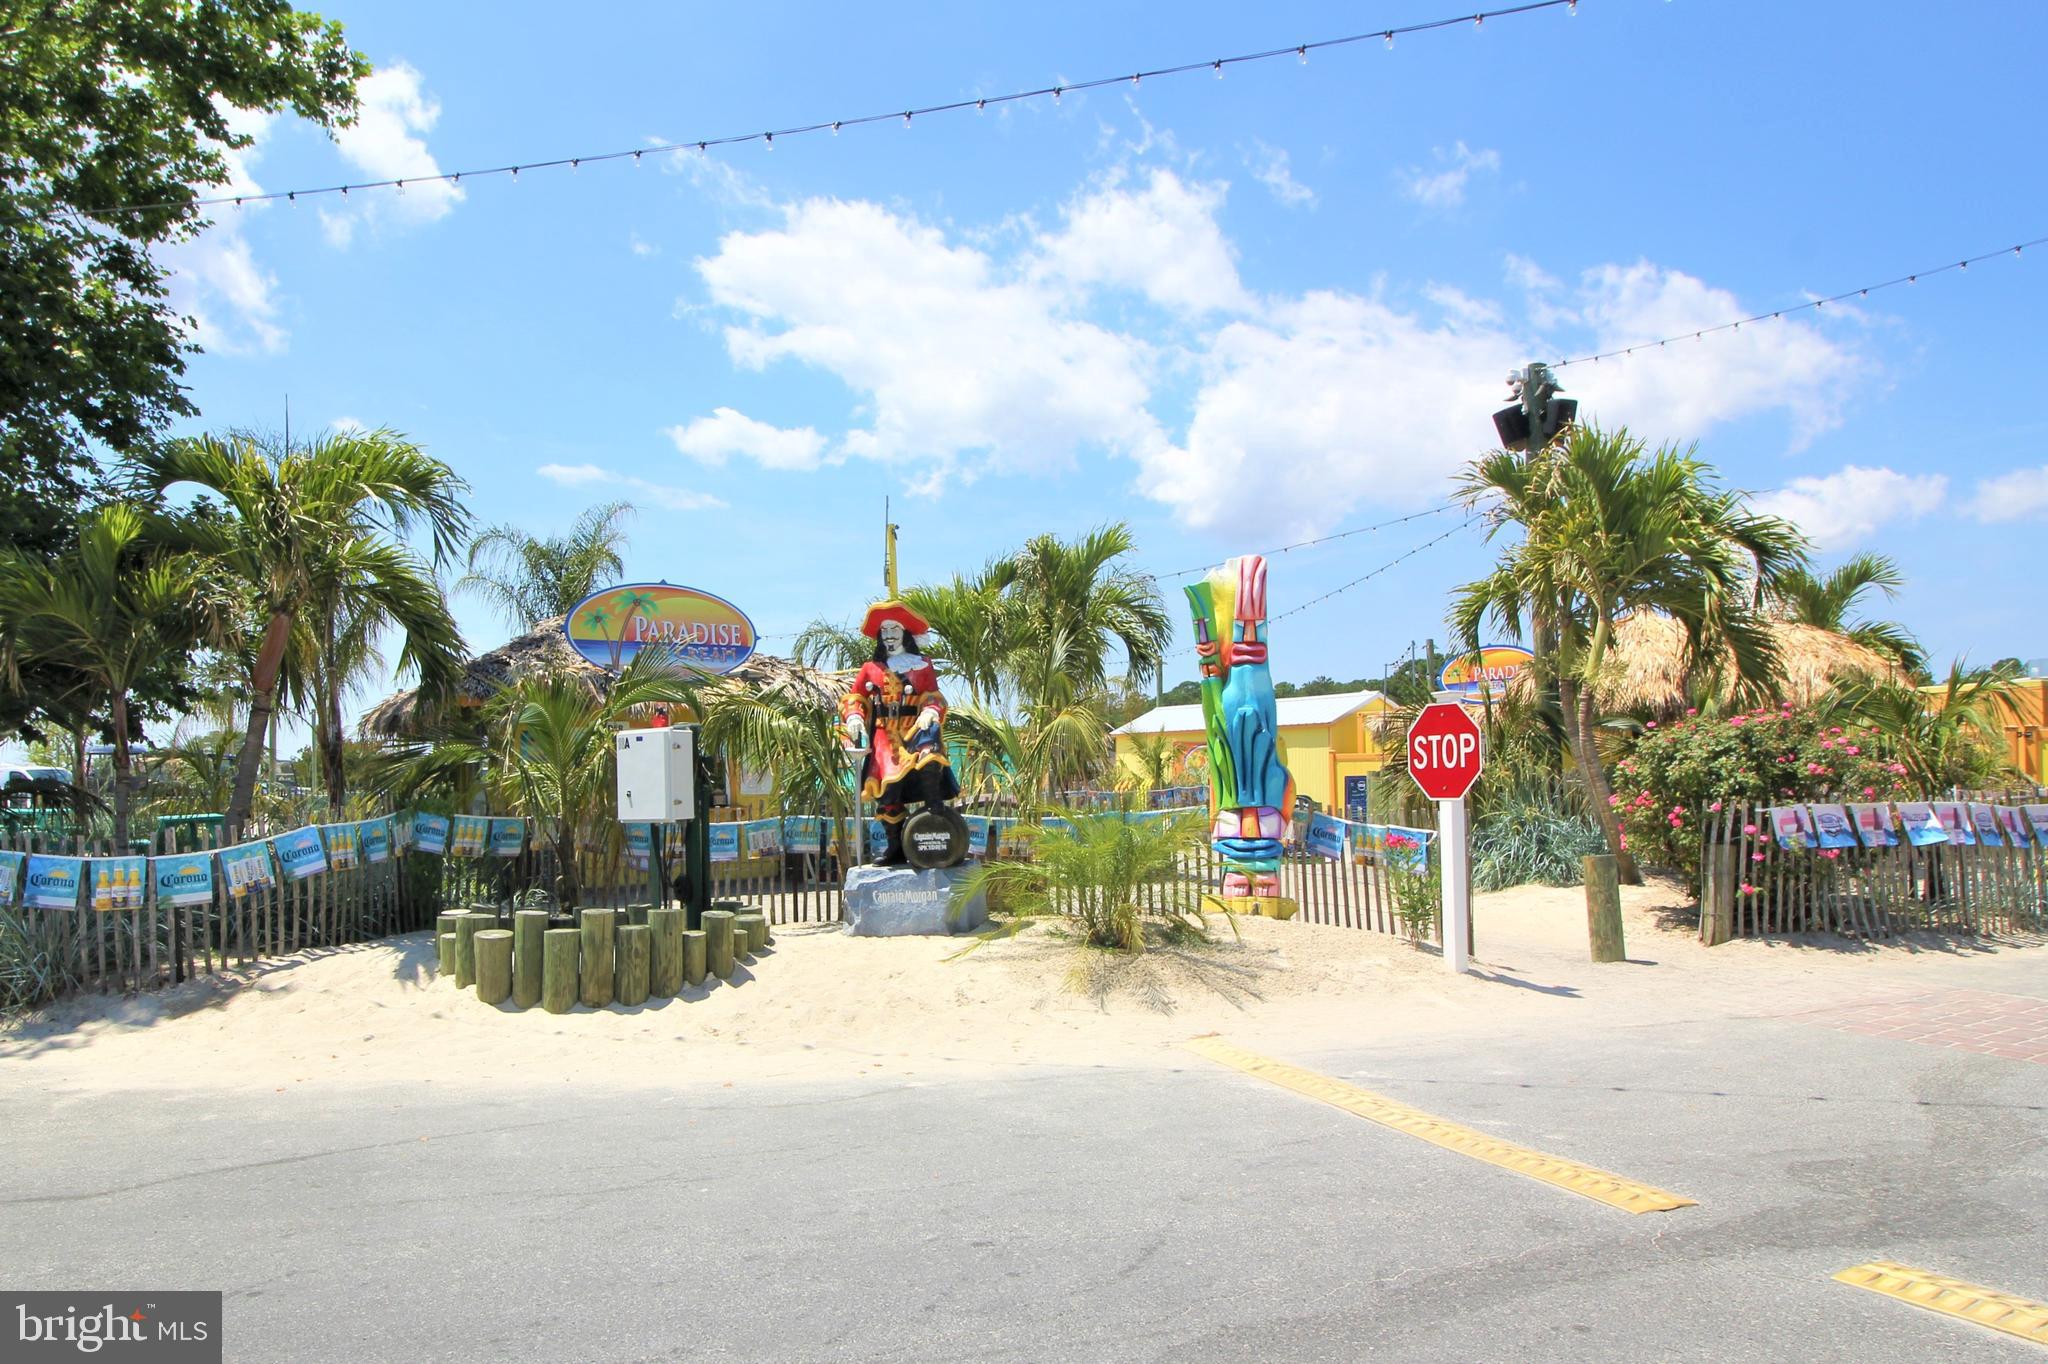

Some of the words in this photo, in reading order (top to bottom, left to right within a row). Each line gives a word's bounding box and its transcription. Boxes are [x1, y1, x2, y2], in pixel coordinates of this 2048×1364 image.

[633, 616, 742, 646] PARADISE
[1413, 733, 1476, 770] STOP
[281, 843, 321, 863] Corona
[30, 873, 75, 888] Corona
[160, 873, 208, 888] Corona
[905, 889, 938, 906] Morgan
